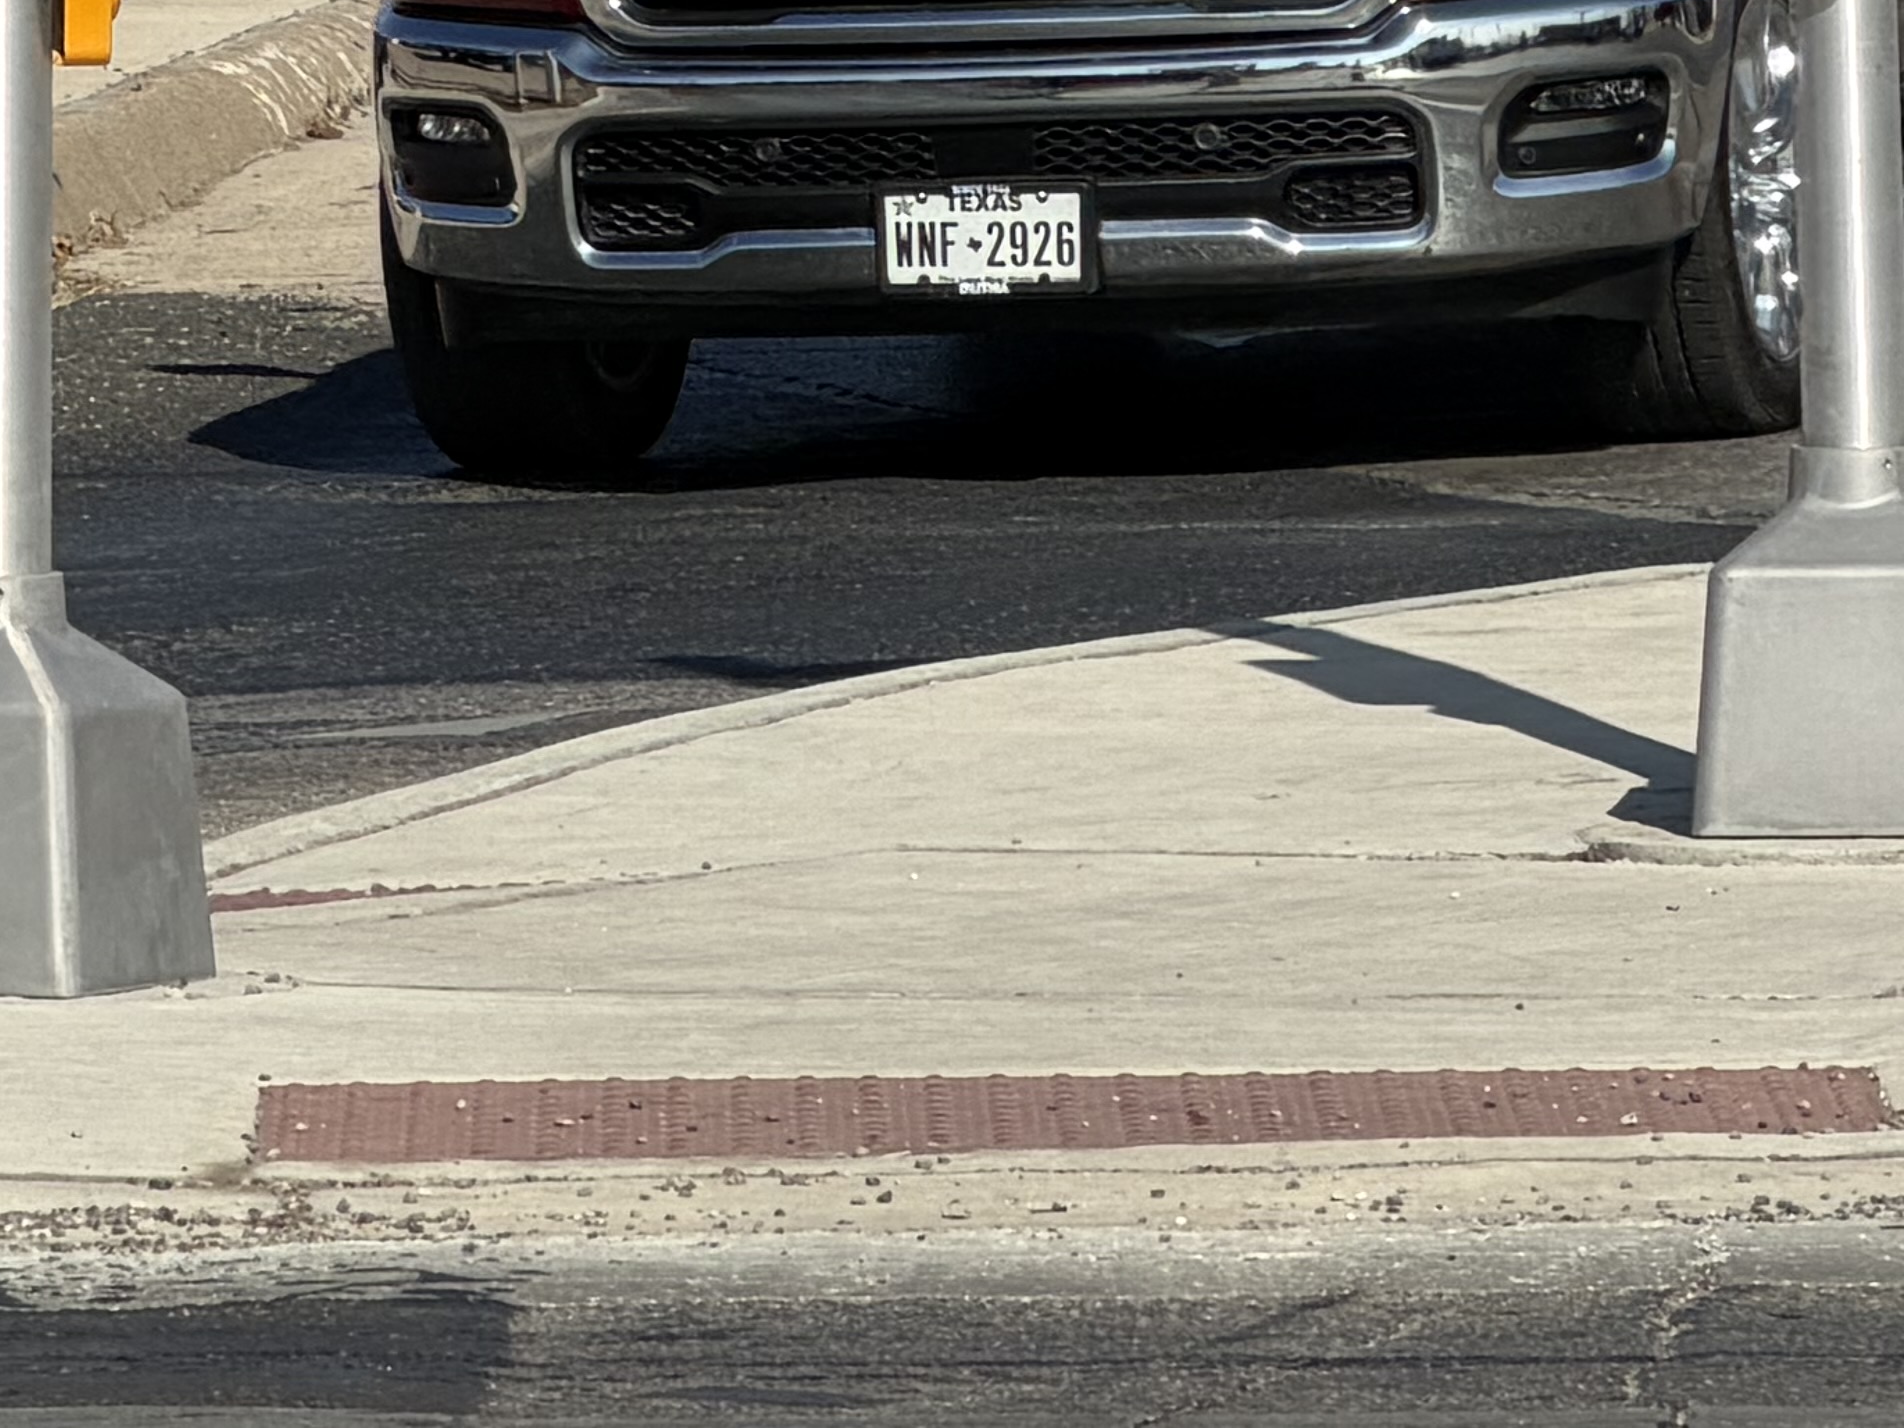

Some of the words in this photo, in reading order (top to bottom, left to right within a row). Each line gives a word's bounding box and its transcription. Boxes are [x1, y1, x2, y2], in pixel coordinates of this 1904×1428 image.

[945, 187, 1023, 213] TEXAS
[894, 220, 959, 268] WNF
[986, 220, 1076, 268] 2926
